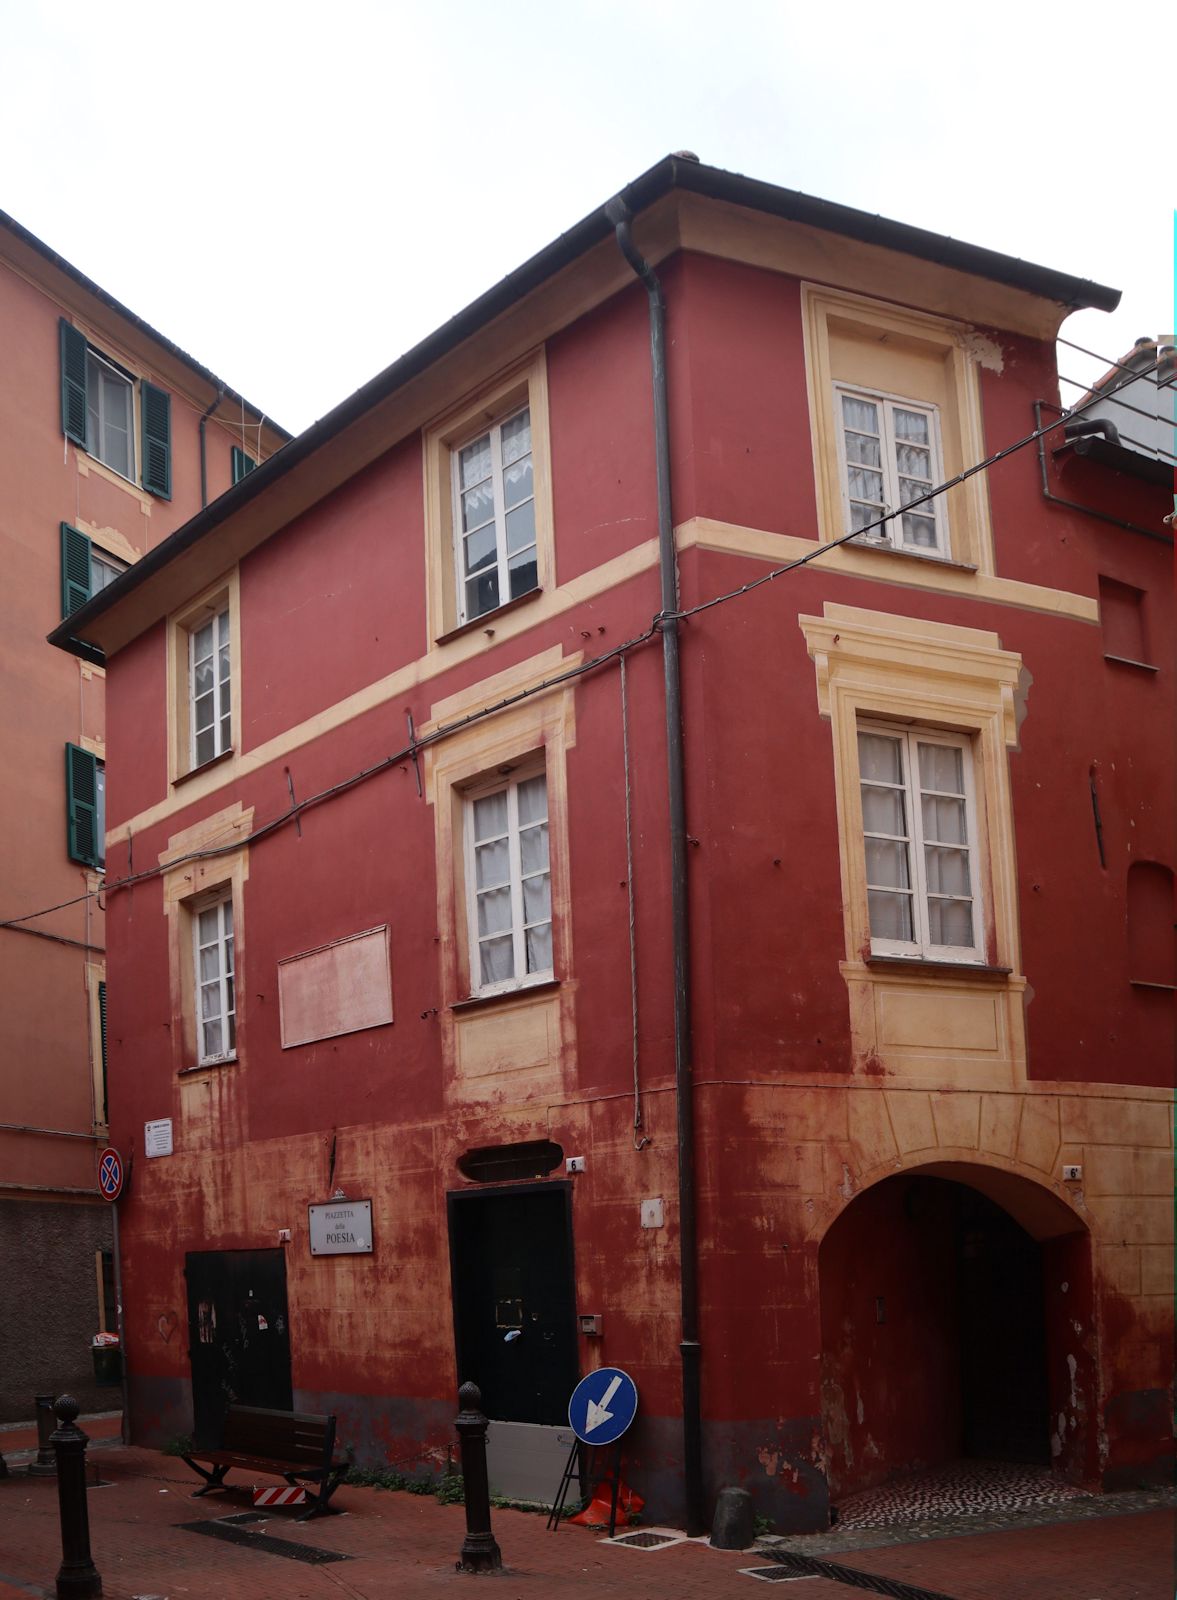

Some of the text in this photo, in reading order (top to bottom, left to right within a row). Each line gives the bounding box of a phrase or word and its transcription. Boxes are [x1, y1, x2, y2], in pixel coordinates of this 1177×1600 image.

[571, 1160, 577, 1170] 6
[325, 1210, 354, 1219] PIAZZETTA
[326, 1232, 356, 1244] POESIA
